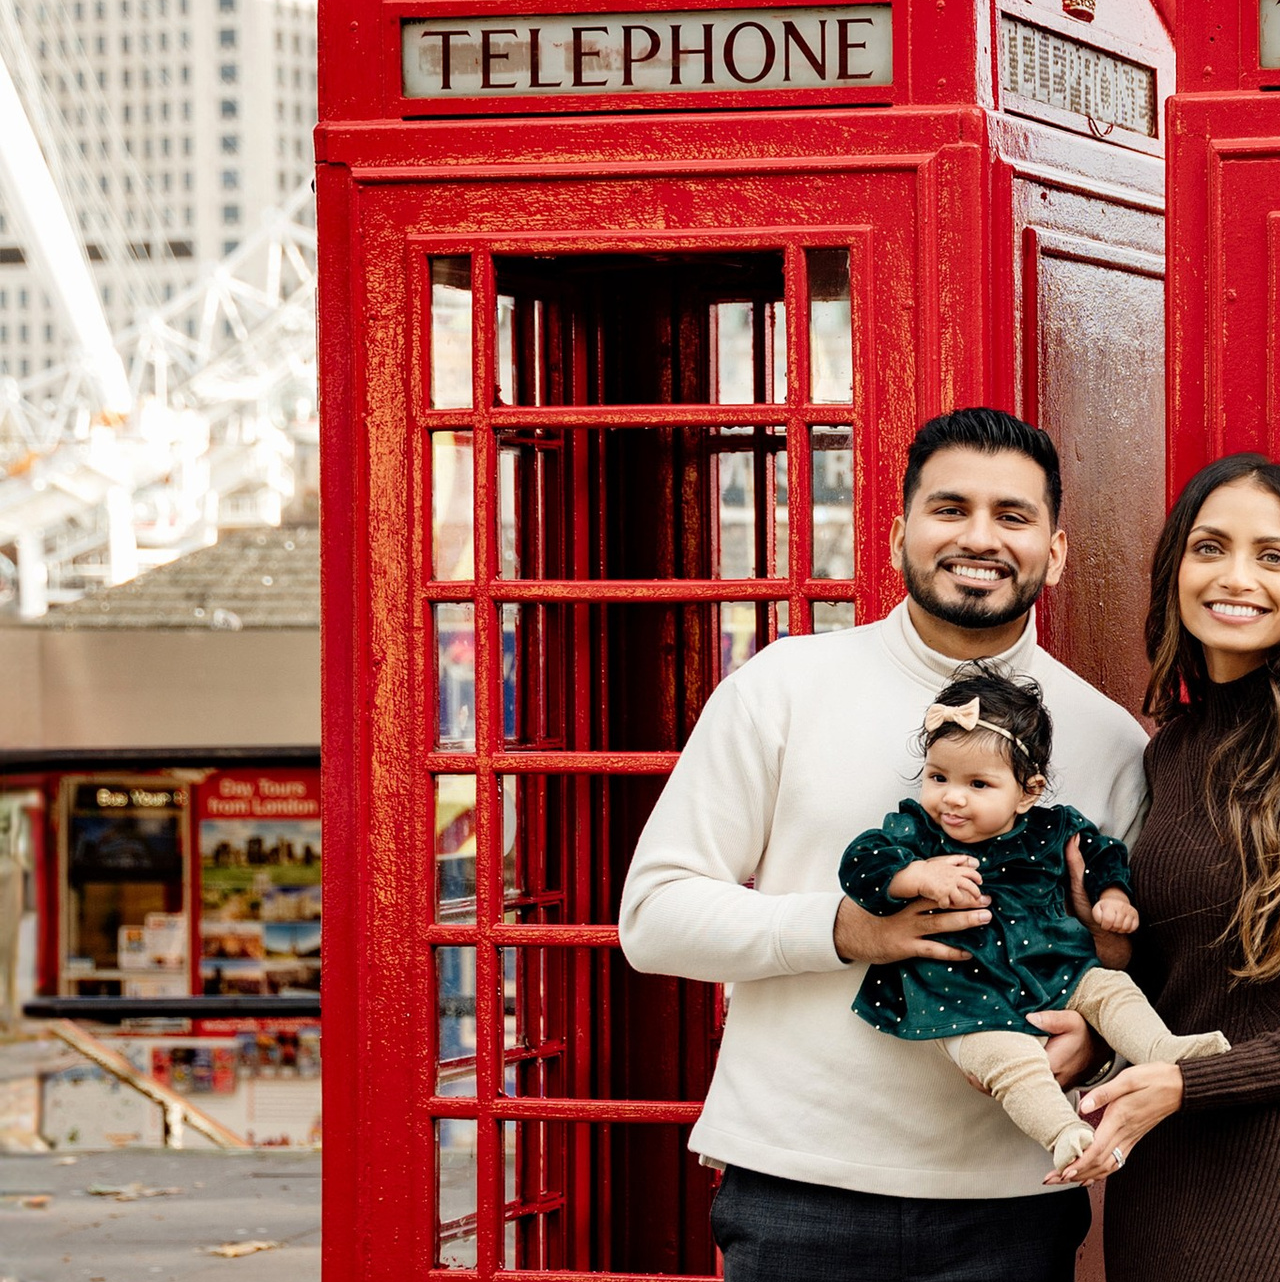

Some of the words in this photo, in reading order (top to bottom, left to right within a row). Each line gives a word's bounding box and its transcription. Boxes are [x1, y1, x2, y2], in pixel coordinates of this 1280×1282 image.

[420, 18, 877, 91] TELEPHONE
[258, 778, 307, 797] Tours
[207, 796, 250, 815] from
[251, 796, 319, 815] London
